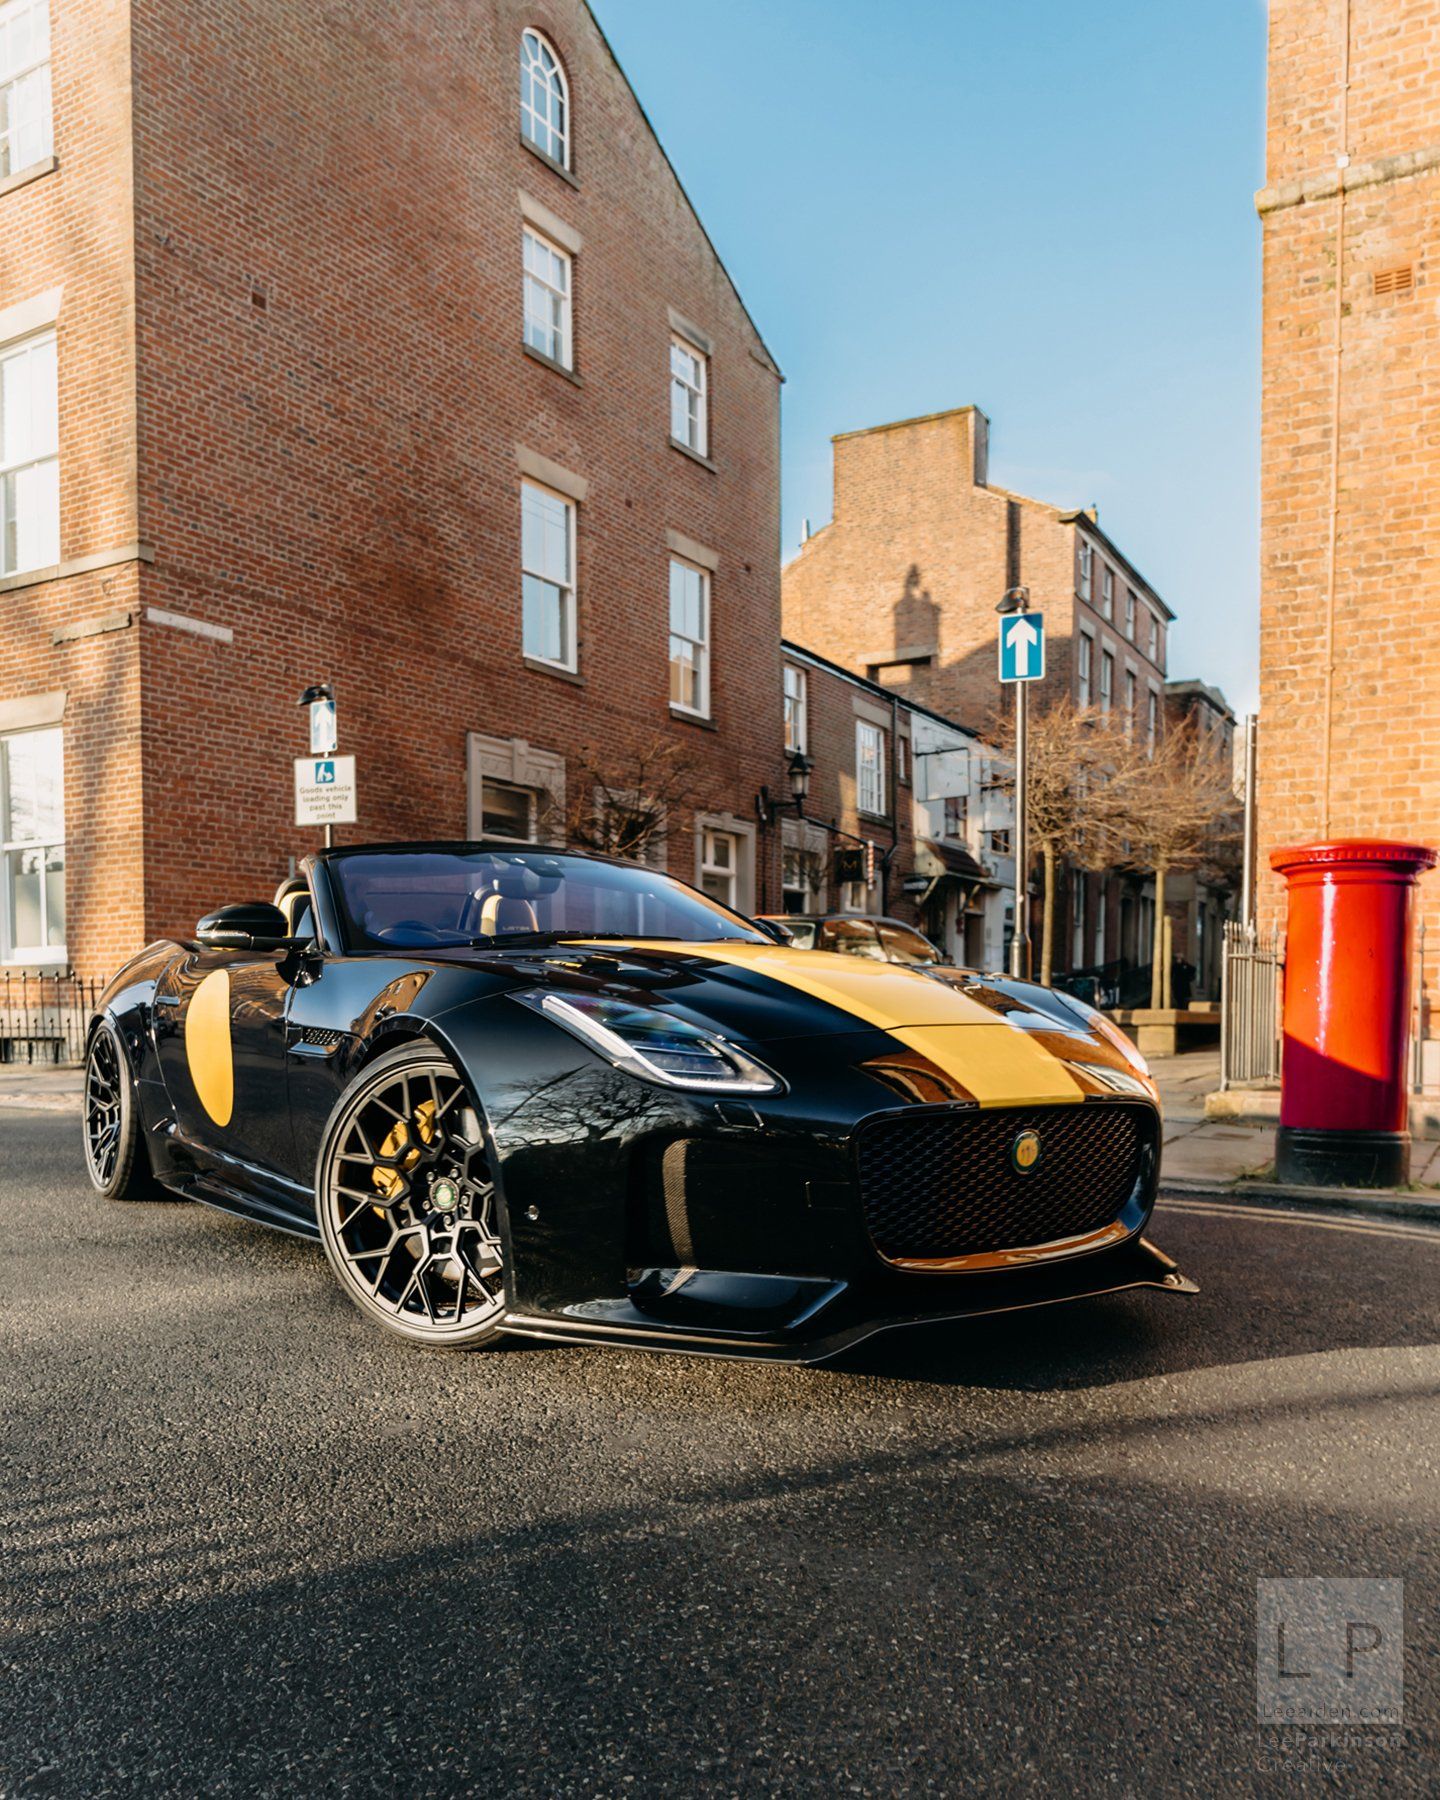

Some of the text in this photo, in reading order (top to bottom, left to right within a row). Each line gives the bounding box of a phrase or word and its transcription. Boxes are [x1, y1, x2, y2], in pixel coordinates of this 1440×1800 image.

[300, 785, 351, 794] Goods vehicle
[332, 794, 349, 802] only
